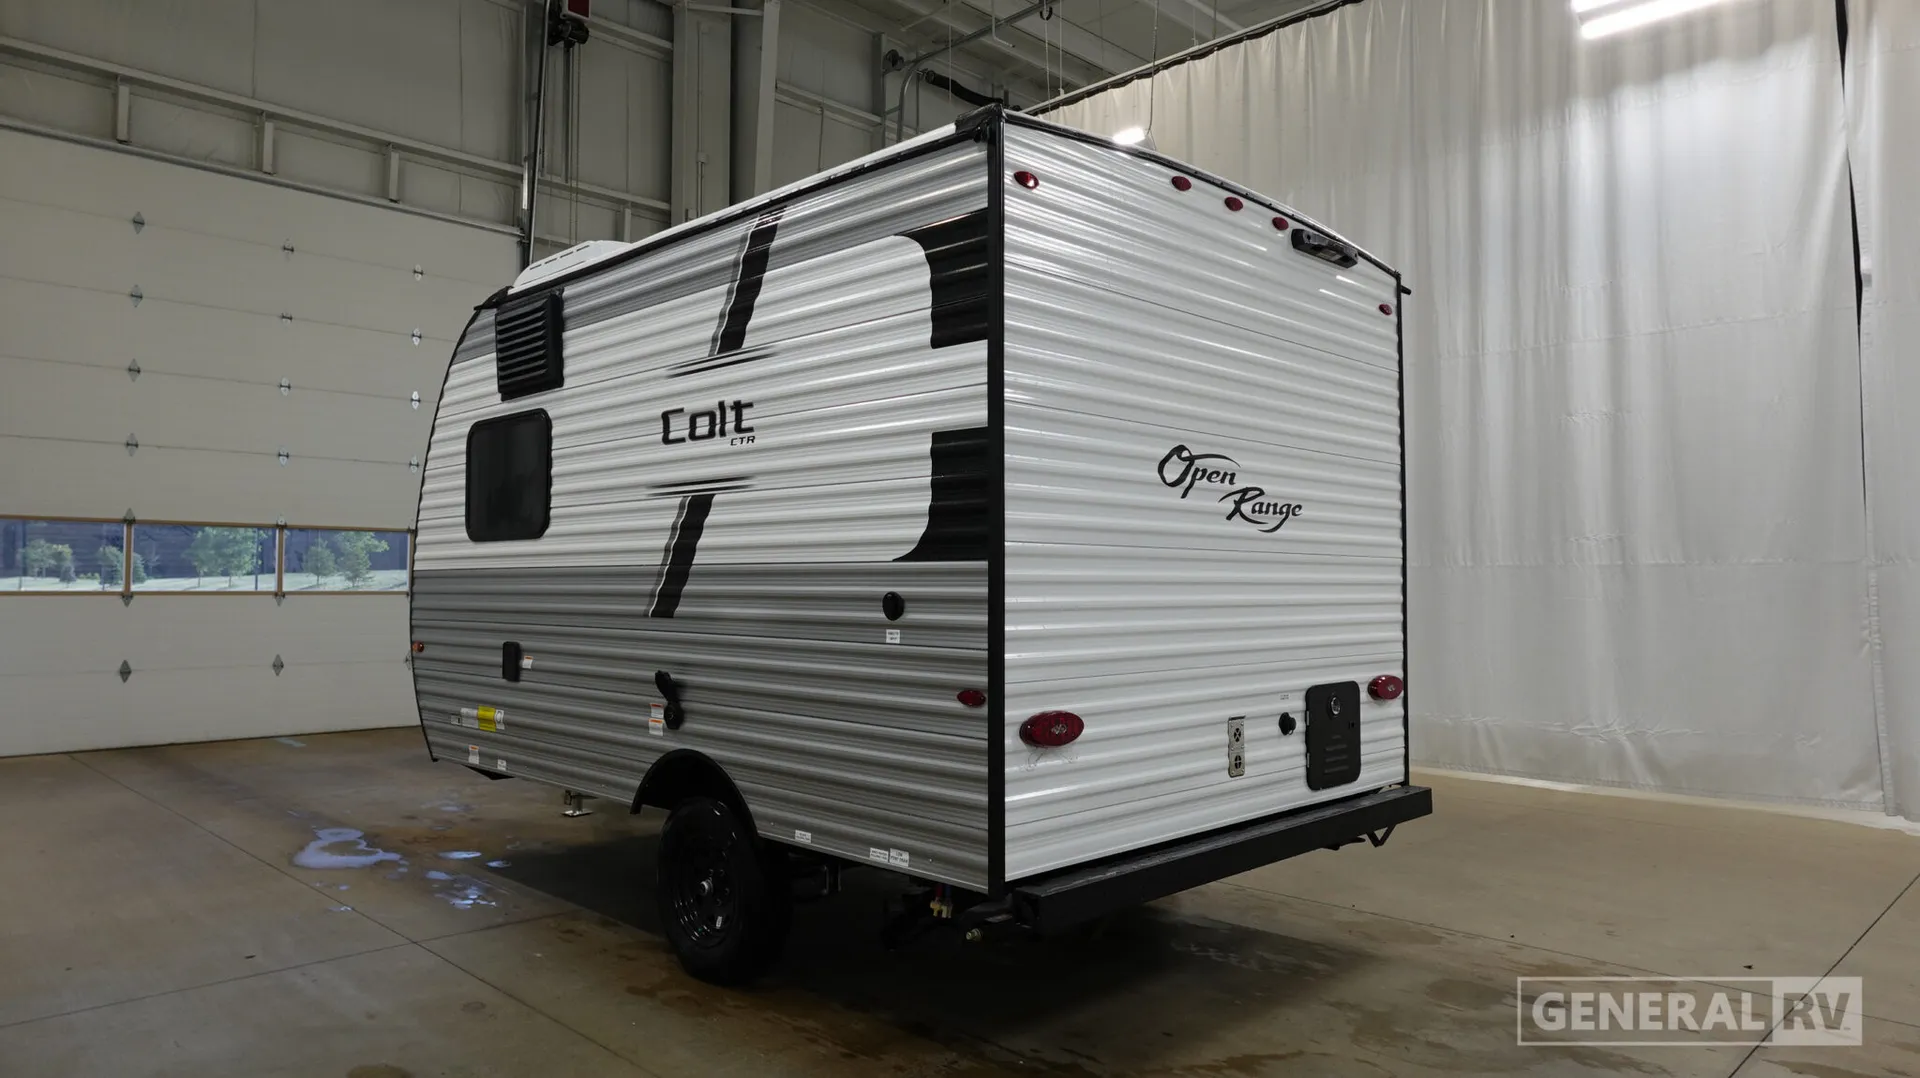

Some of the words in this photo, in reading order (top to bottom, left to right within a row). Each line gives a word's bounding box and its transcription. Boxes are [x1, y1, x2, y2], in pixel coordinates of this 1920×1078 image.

[662, 400, 755, 445] Colt
[730, 436, 755, 446] CTR
[1157, 444, 1241, 499] Open
[1218, 486, 1303, 533] Range
